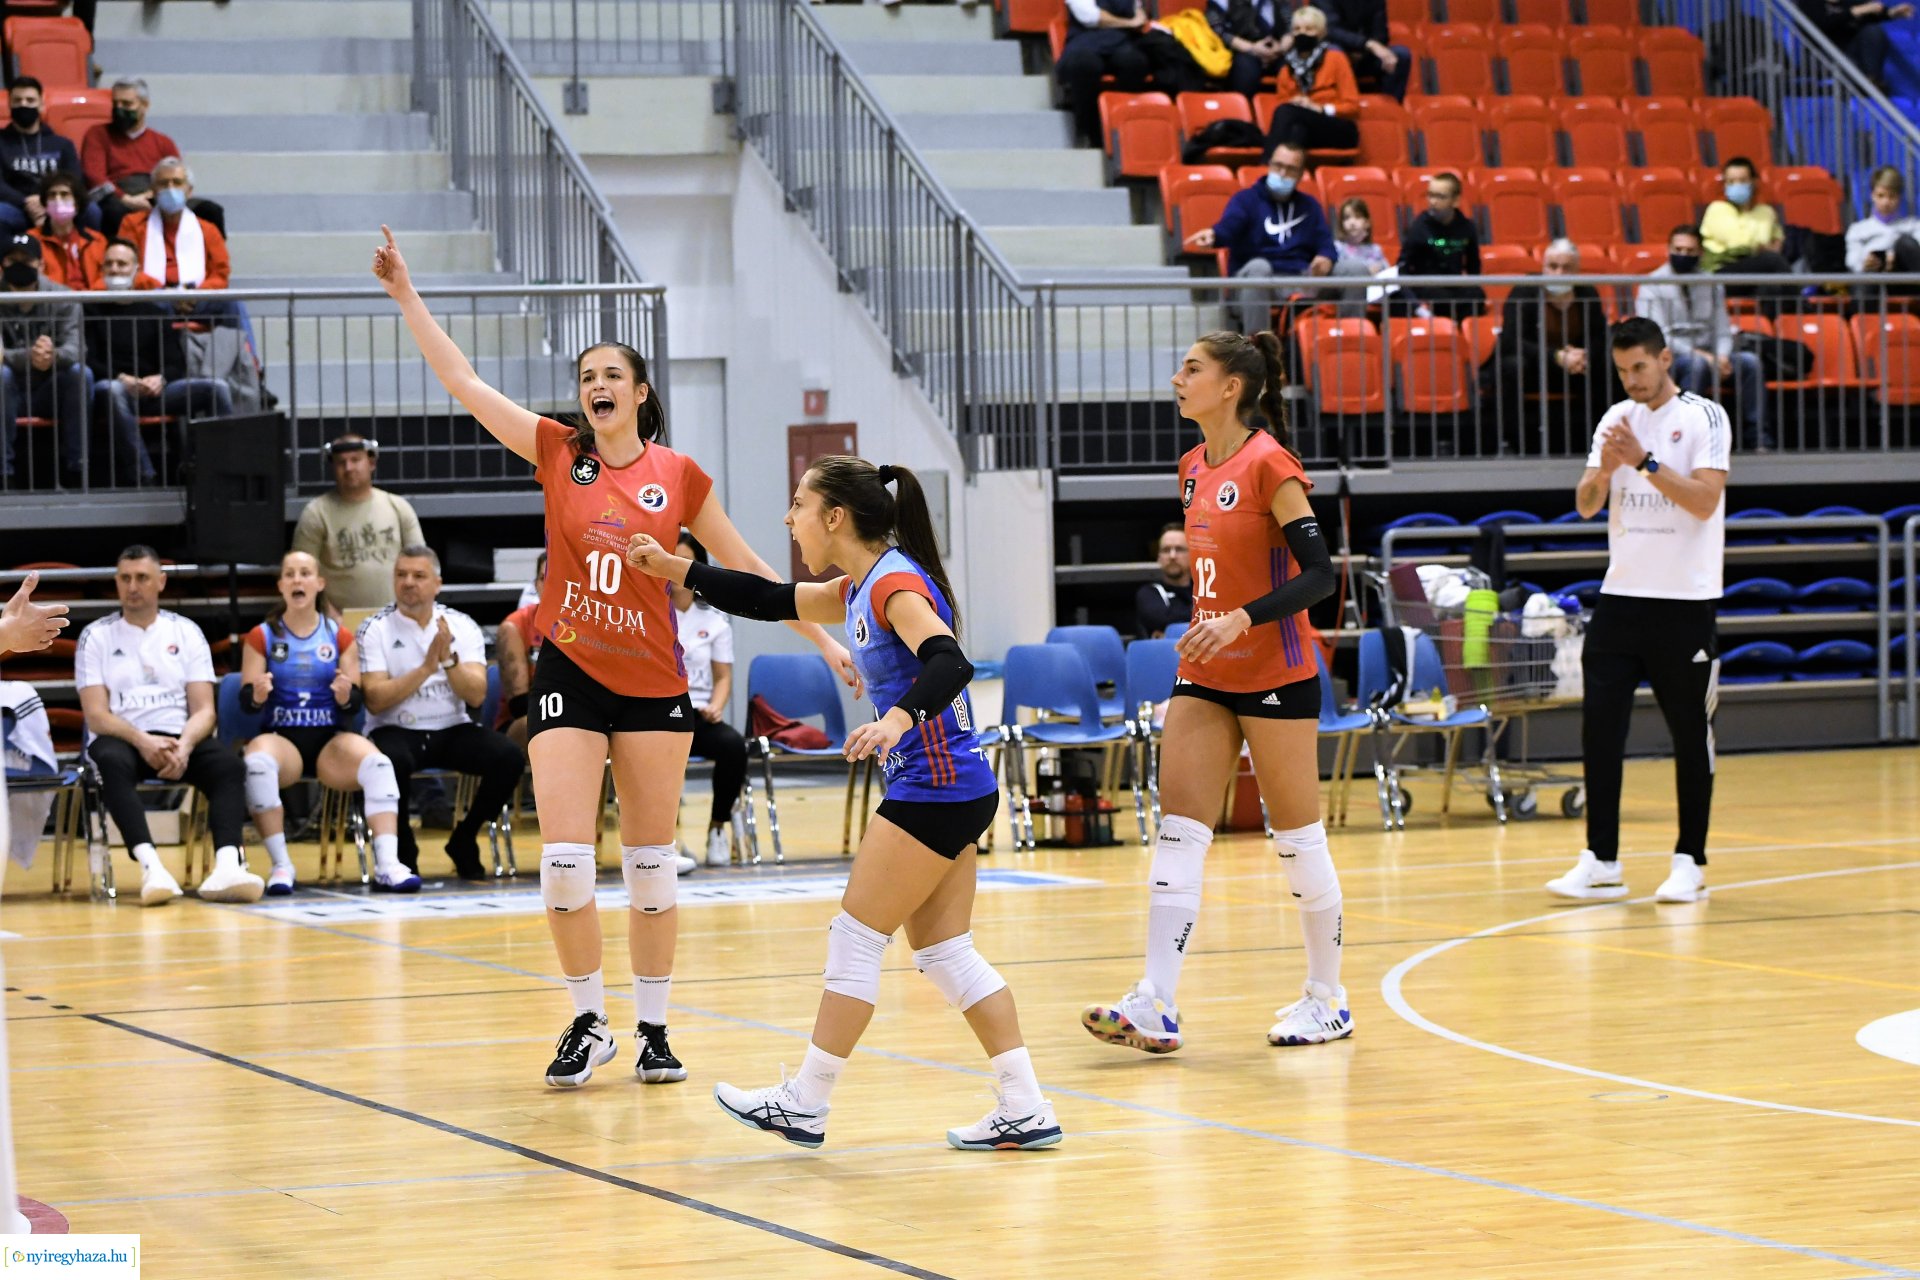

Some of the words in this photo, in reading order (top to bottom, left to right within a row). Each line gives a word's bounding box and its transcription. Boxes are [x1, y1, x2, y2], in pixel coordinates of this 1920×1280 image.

[585, 550, 622, 595] 10
[1195, 557, 1217, 599] 12
[561, 580, 646, 630] FATUM
[272, 706, 334, 725] FATUM
[298, 691, 311, 707] 7
[539, 692, 563, 721] 10
